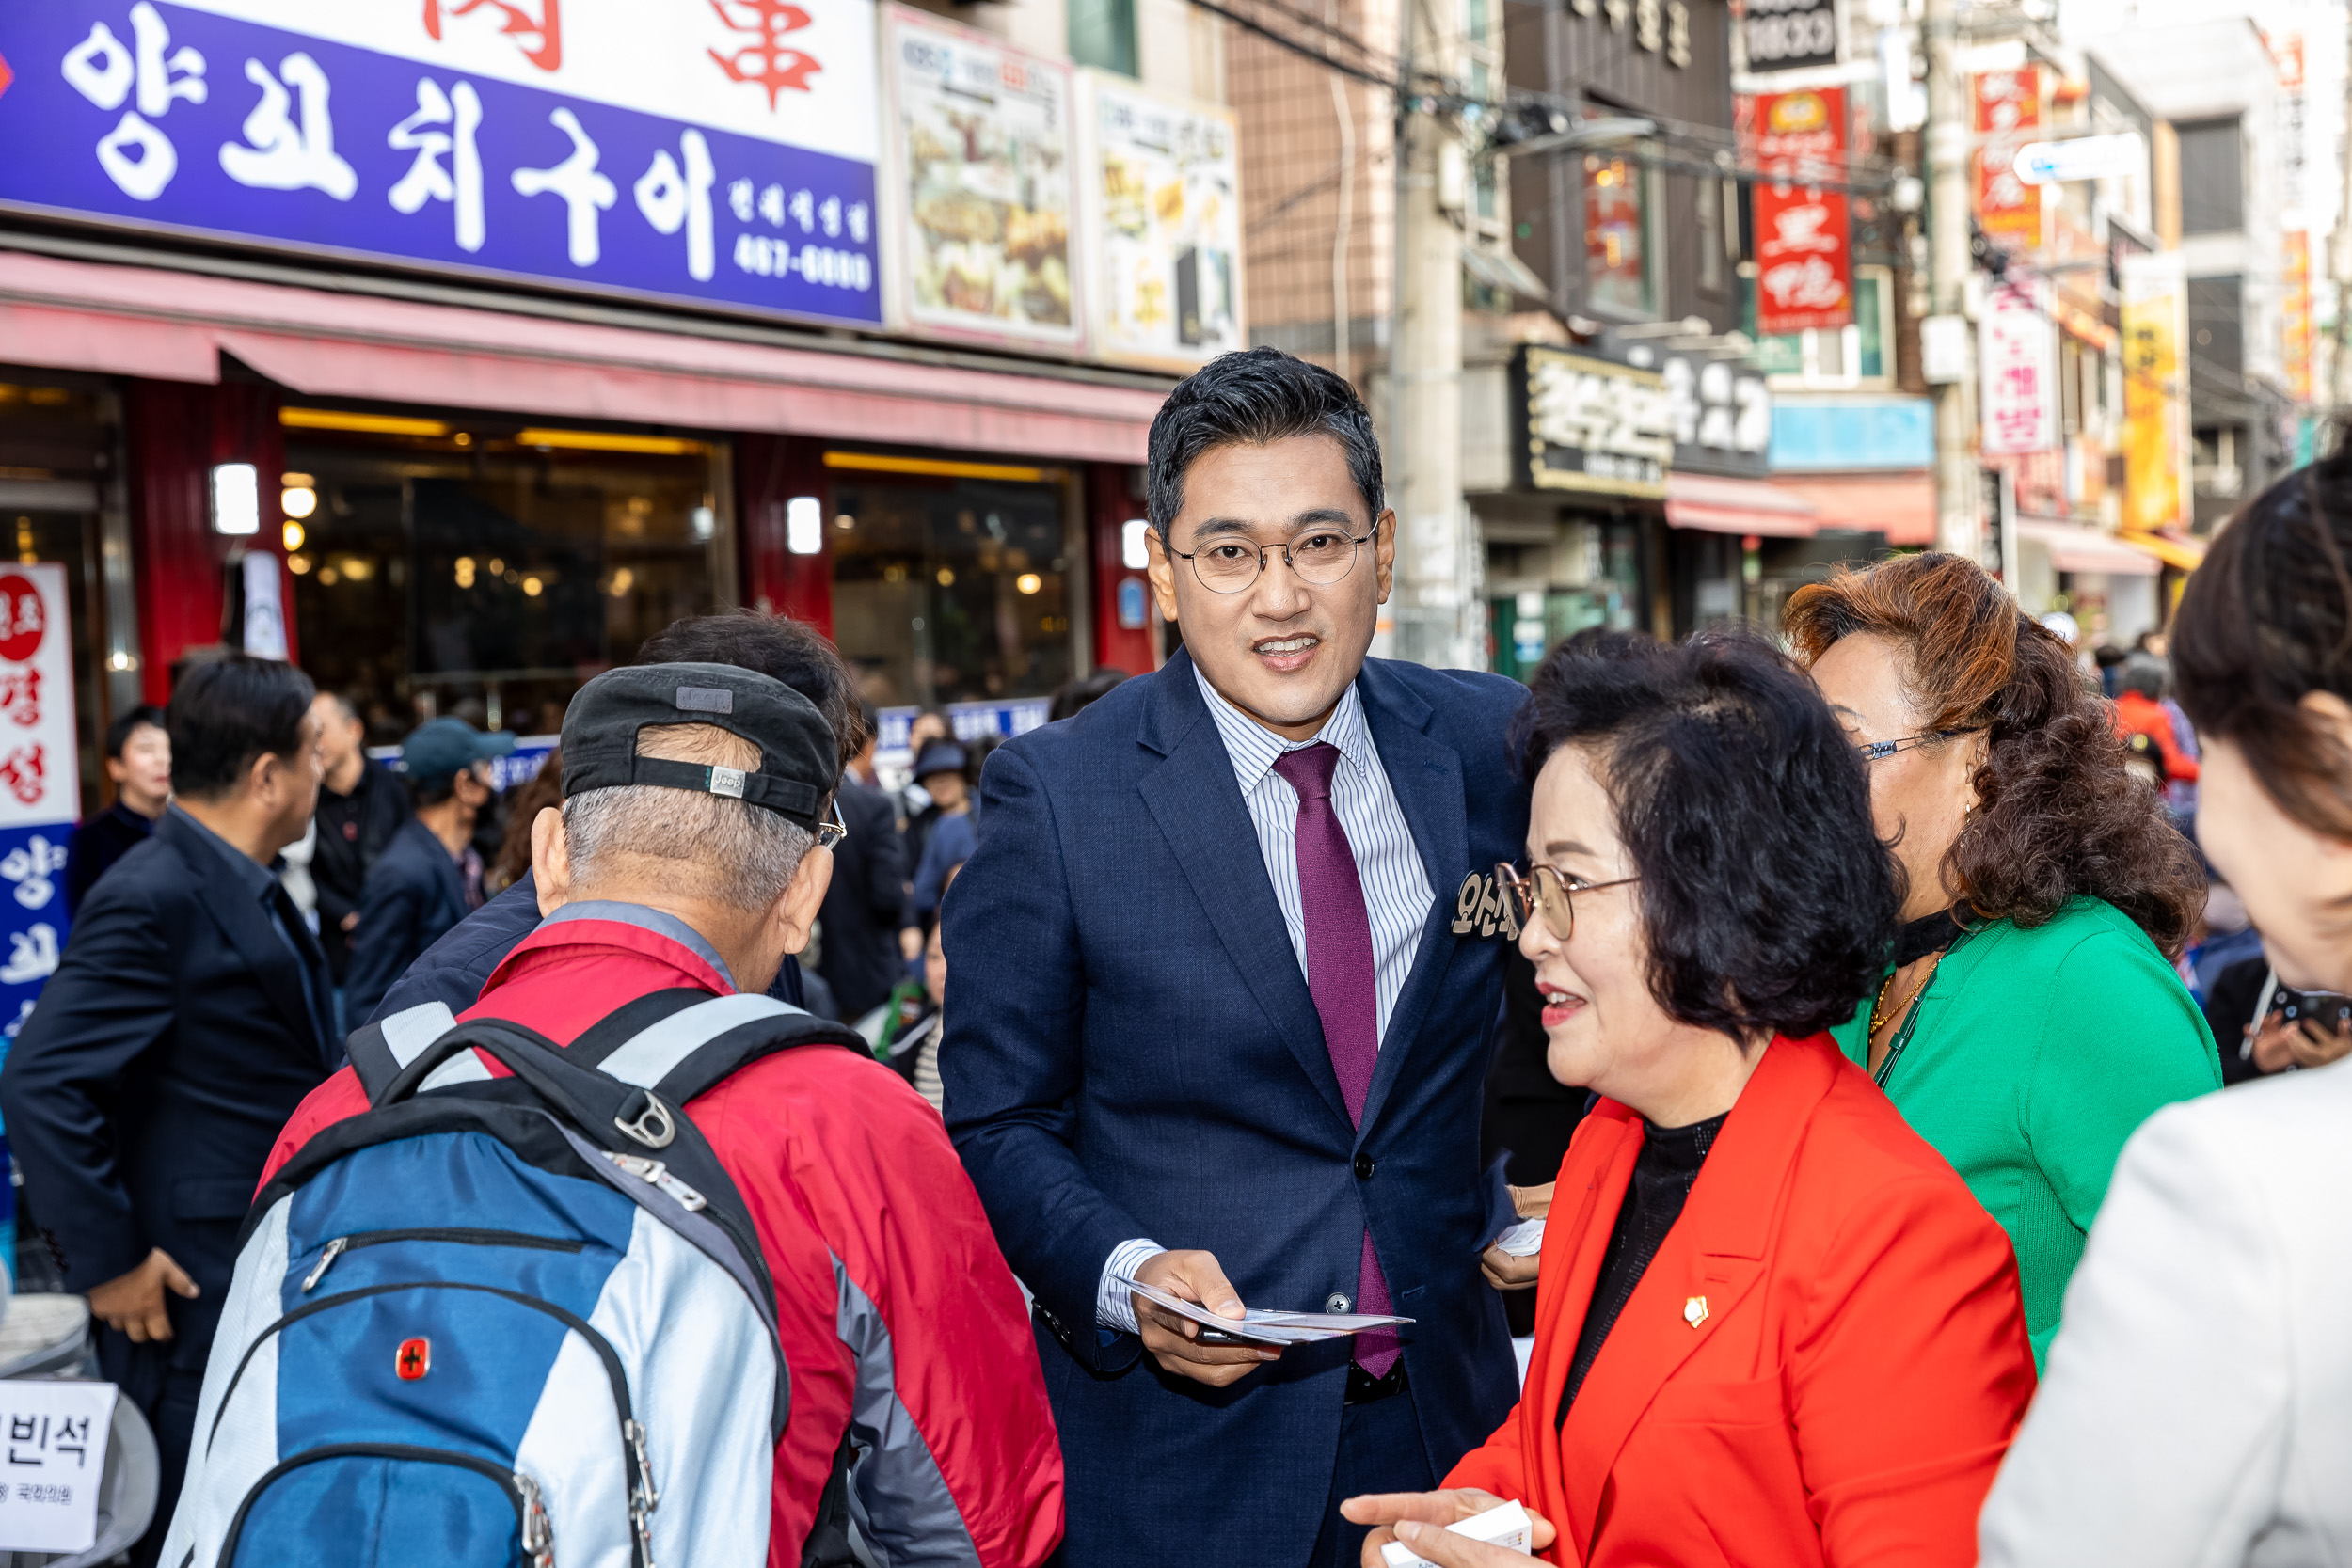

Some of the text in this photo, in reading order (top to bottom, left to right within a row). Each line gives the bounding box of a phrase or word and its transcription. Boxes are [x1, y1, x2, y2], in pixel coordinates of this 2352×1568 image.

[60, 0, 716, 282] 양꼬치구이
[682, 689, 727, 708] Jeep
[714, 774, 741, 788] Jeep
